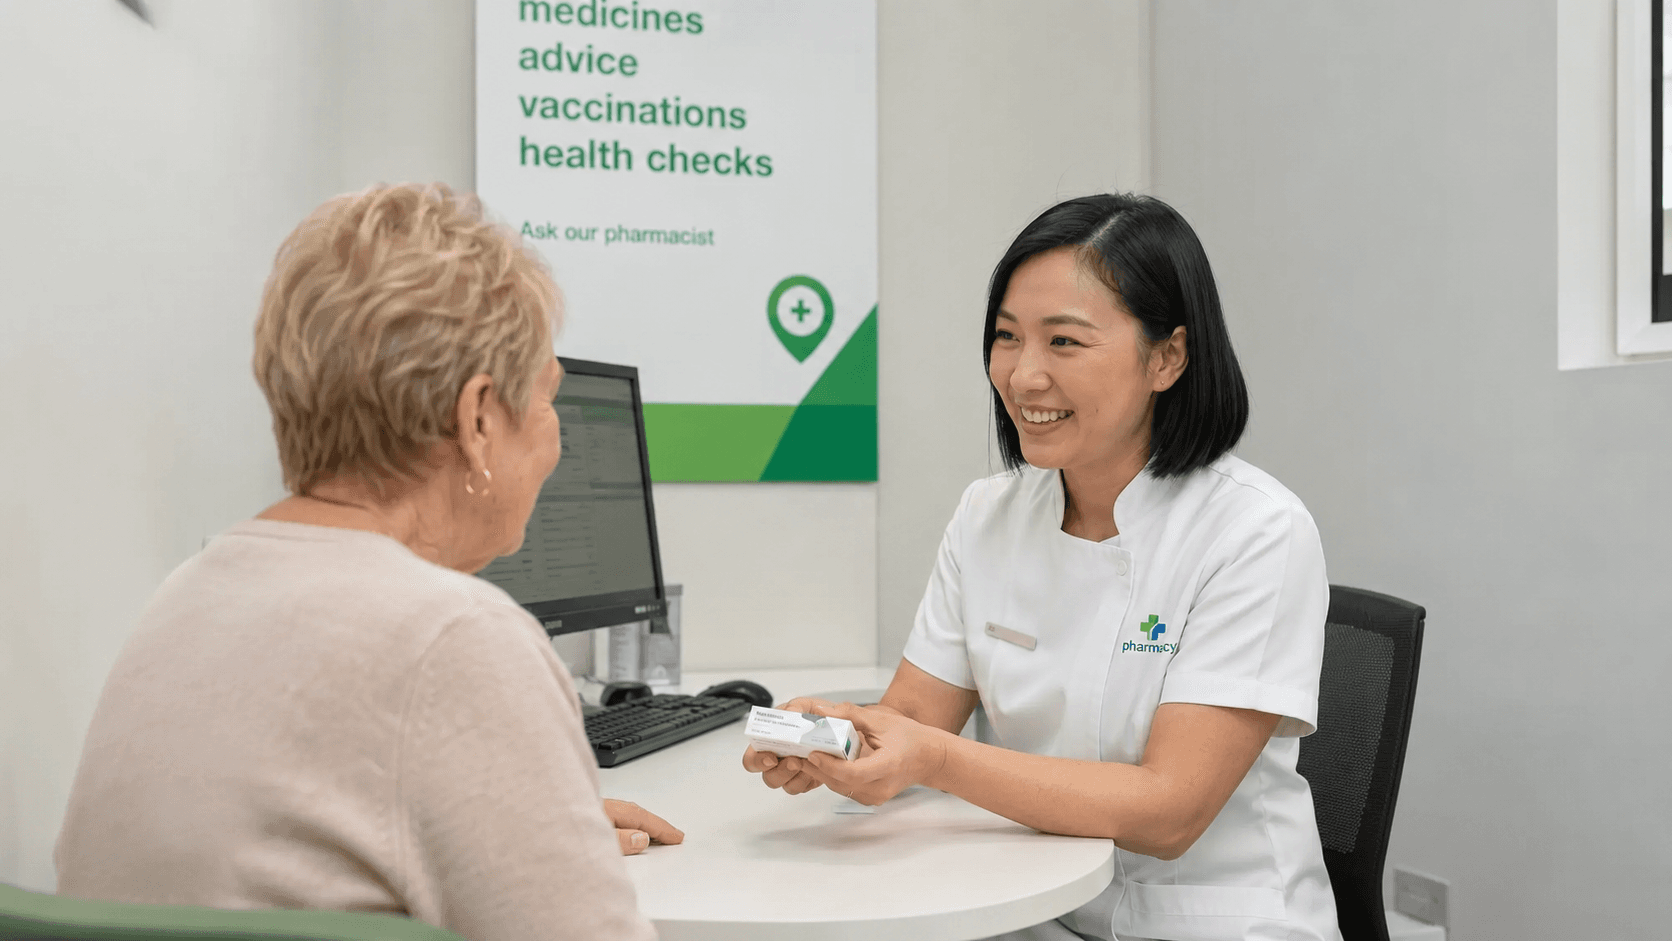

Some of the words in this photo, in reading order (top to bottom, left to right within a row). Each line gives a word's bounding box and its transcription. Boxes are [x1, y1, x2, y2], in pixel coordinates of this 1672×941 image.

[519, 0, 704, 35] medicines
[519, 42, 638, 77] advice
[519, 93, 747, 130] vaccinations
[520, 136, 633, 171] health
[647, 143, 773, 177] checks
[520, 220, 558, 240] Ask
[564, 226, 599, 241] our
[604, 224, 715, 246] pharmacist
[1122, 640, 1177, 654] pharmacy
